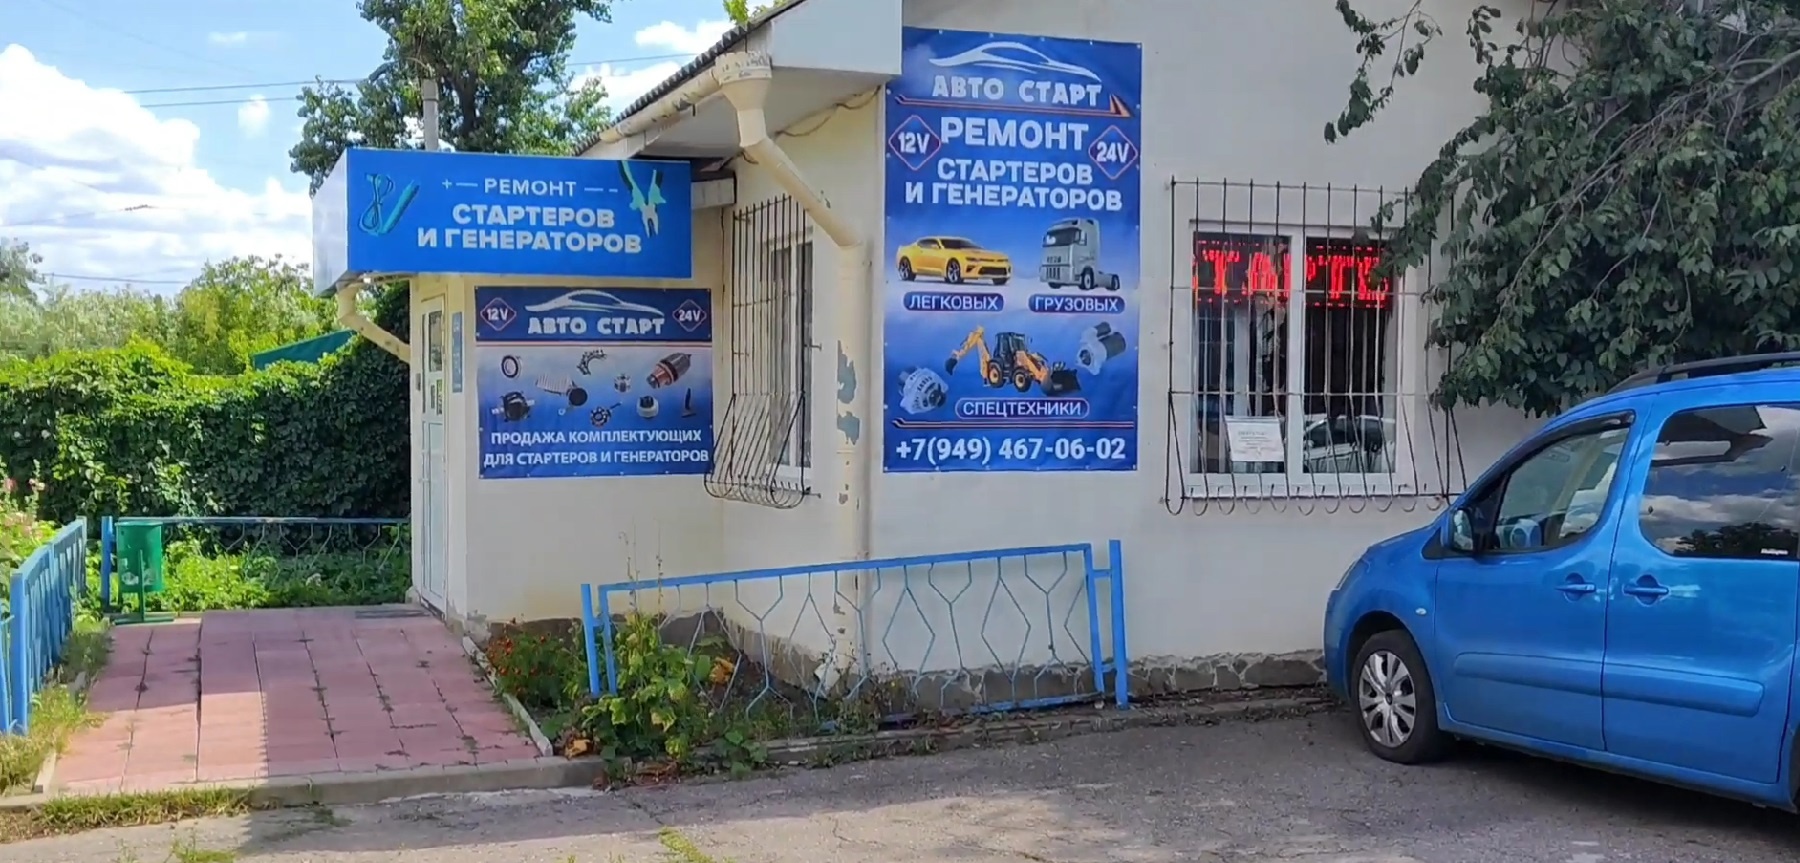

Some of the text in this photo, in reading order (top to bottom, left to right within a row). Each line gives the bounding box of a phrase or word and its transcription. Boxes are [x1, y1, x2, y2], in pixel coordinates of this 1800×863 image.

[932, 75, 1103, 107] АВТО СТАРТ
[898, 132, 930, 154] 12V
[941, 116, 1089, 150] РЕМОНТ
[1096, 141, 1129, 163] 24V
[937, 158, 1093, 185] СТАРТЕРОВ
[484, 177, 577, 197] РЕМОНТ
[905, 181, 1122, 211] И ГЕНЕРАТОРОВ
[452, 203, 615, 228] СТАРТЕРОВ
[417, 227, 642, 254] И ГЕНЕРАТОРОВ
[909, 295, 999, 311] ЛЕГКОВЫХ
[1035, 296, 1119, 312] ГРУЗОВЫХ
[486, 308, 508, 320] 12V
[679, 309, 700, 322] 24V
[528, 317, 665, 334] АВТО СТАРТ
[963, 401, 1082, 418] СПЕЦТЕХНИКИ
[491, 429, 702, 447] ПРОДАЖА КОМПЛЕКТУЮЩИХ
[483, 449, 710, 468] ДЛЯ СТАРТЕРОВ И ГЕНЕРАТОРОВ
[896, 437, 1126, 464] +7(949) 467-06-02
